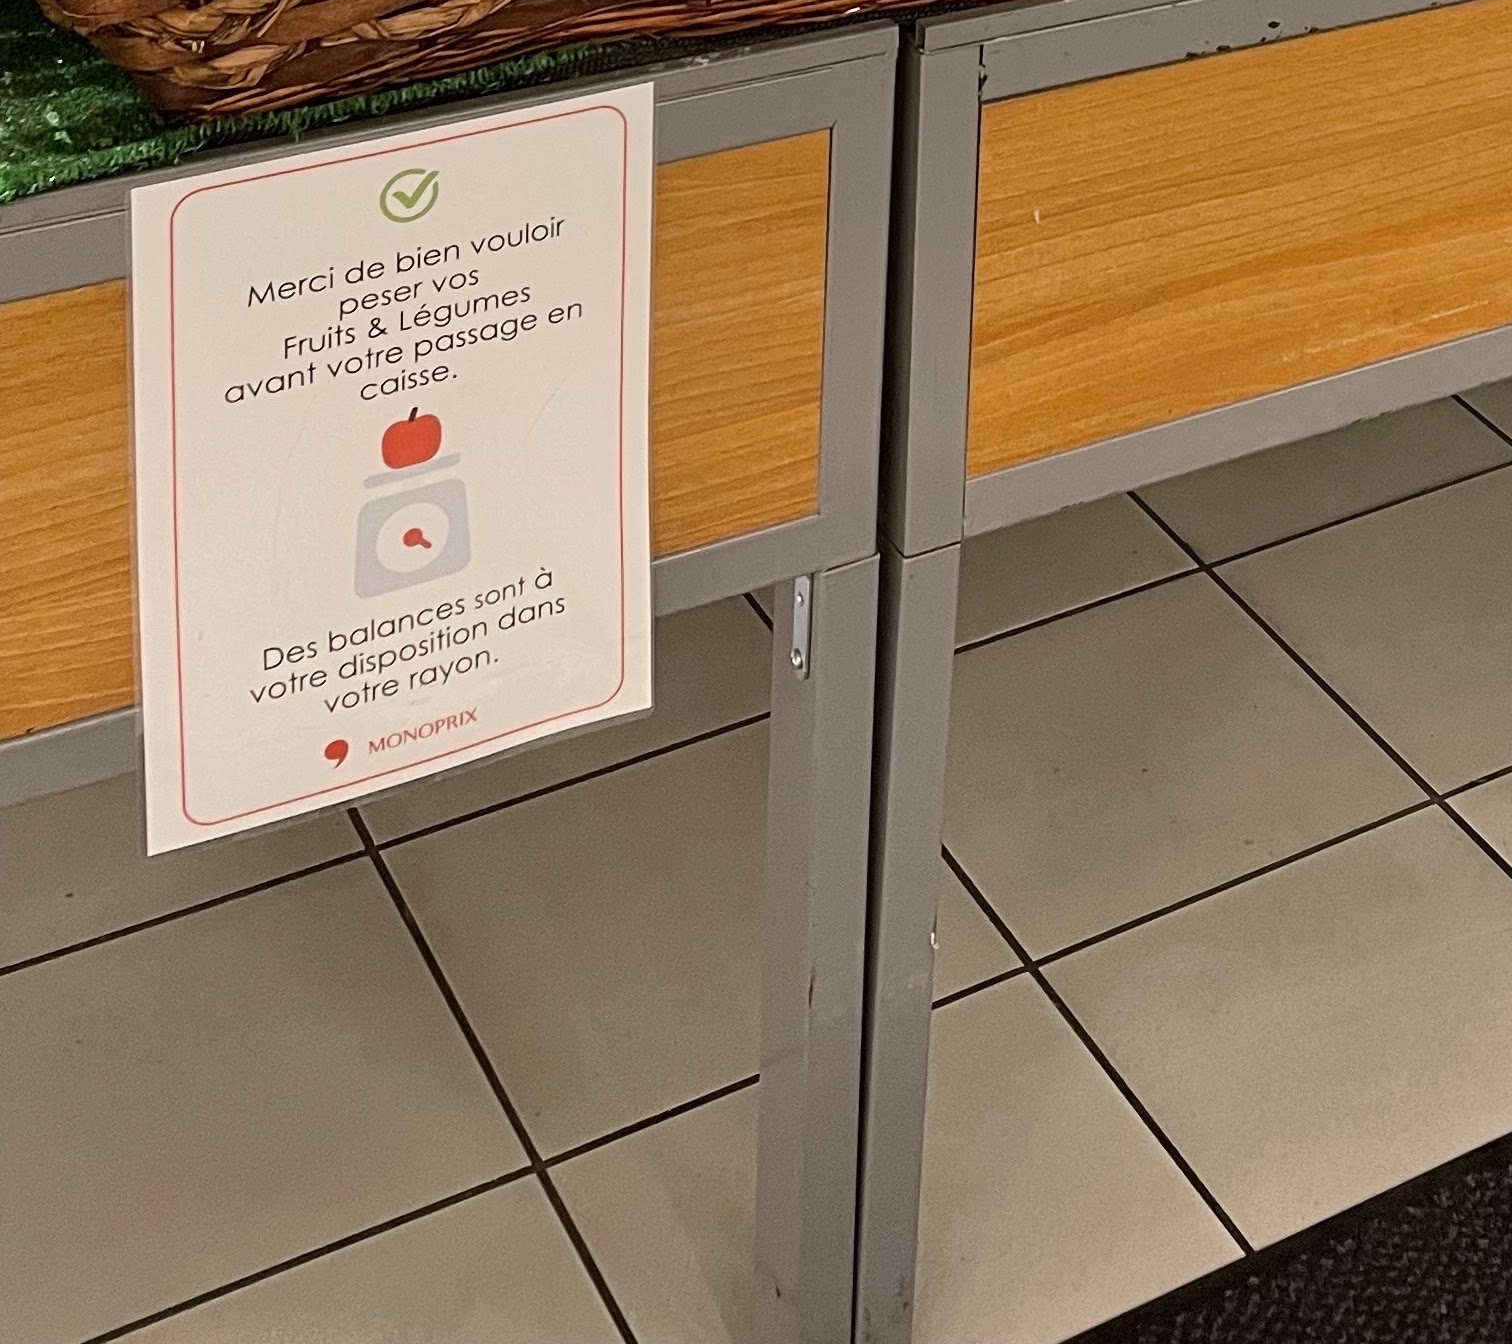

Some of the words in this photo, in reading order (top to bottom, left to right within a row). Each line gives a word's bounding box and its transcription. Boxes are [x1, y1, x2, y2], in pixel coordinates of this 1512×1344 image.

[246, 264, 336, 308] Merci
[344, 257, 386, 287] de
[396, 242, 461, 276] bien
[470, 214, 566, 258] vouloir
[338, 279, 423, 322] peser
[432, 267, 480, 295] vos
[223, 364, 317, 405] avant
[326, 338, 404, 379] votre
[413, 315, 538, 364] passage
[547, 299, 584, 325] en
[283, 323, 357, 361] Fruits
[367, 317, 388, 340] &
[399, 283, 532, 332] Légumes
[359, 361, 459, 402] caisse.
[249, 667, 328, 705] votre
[337, 618, 488, 683] disposition
[497, 593, 567, 632] dans
[262, 639, 319, 672] Des
[327, 599, 467, 655] balances
[473, 576, 527, 611] sont
[533, 565, 554, 591] à
[323, 677, 400, 714] votre
[408, 648, 500, 693] rayon.
[367, 706, 480, 756] MONOPRIX
